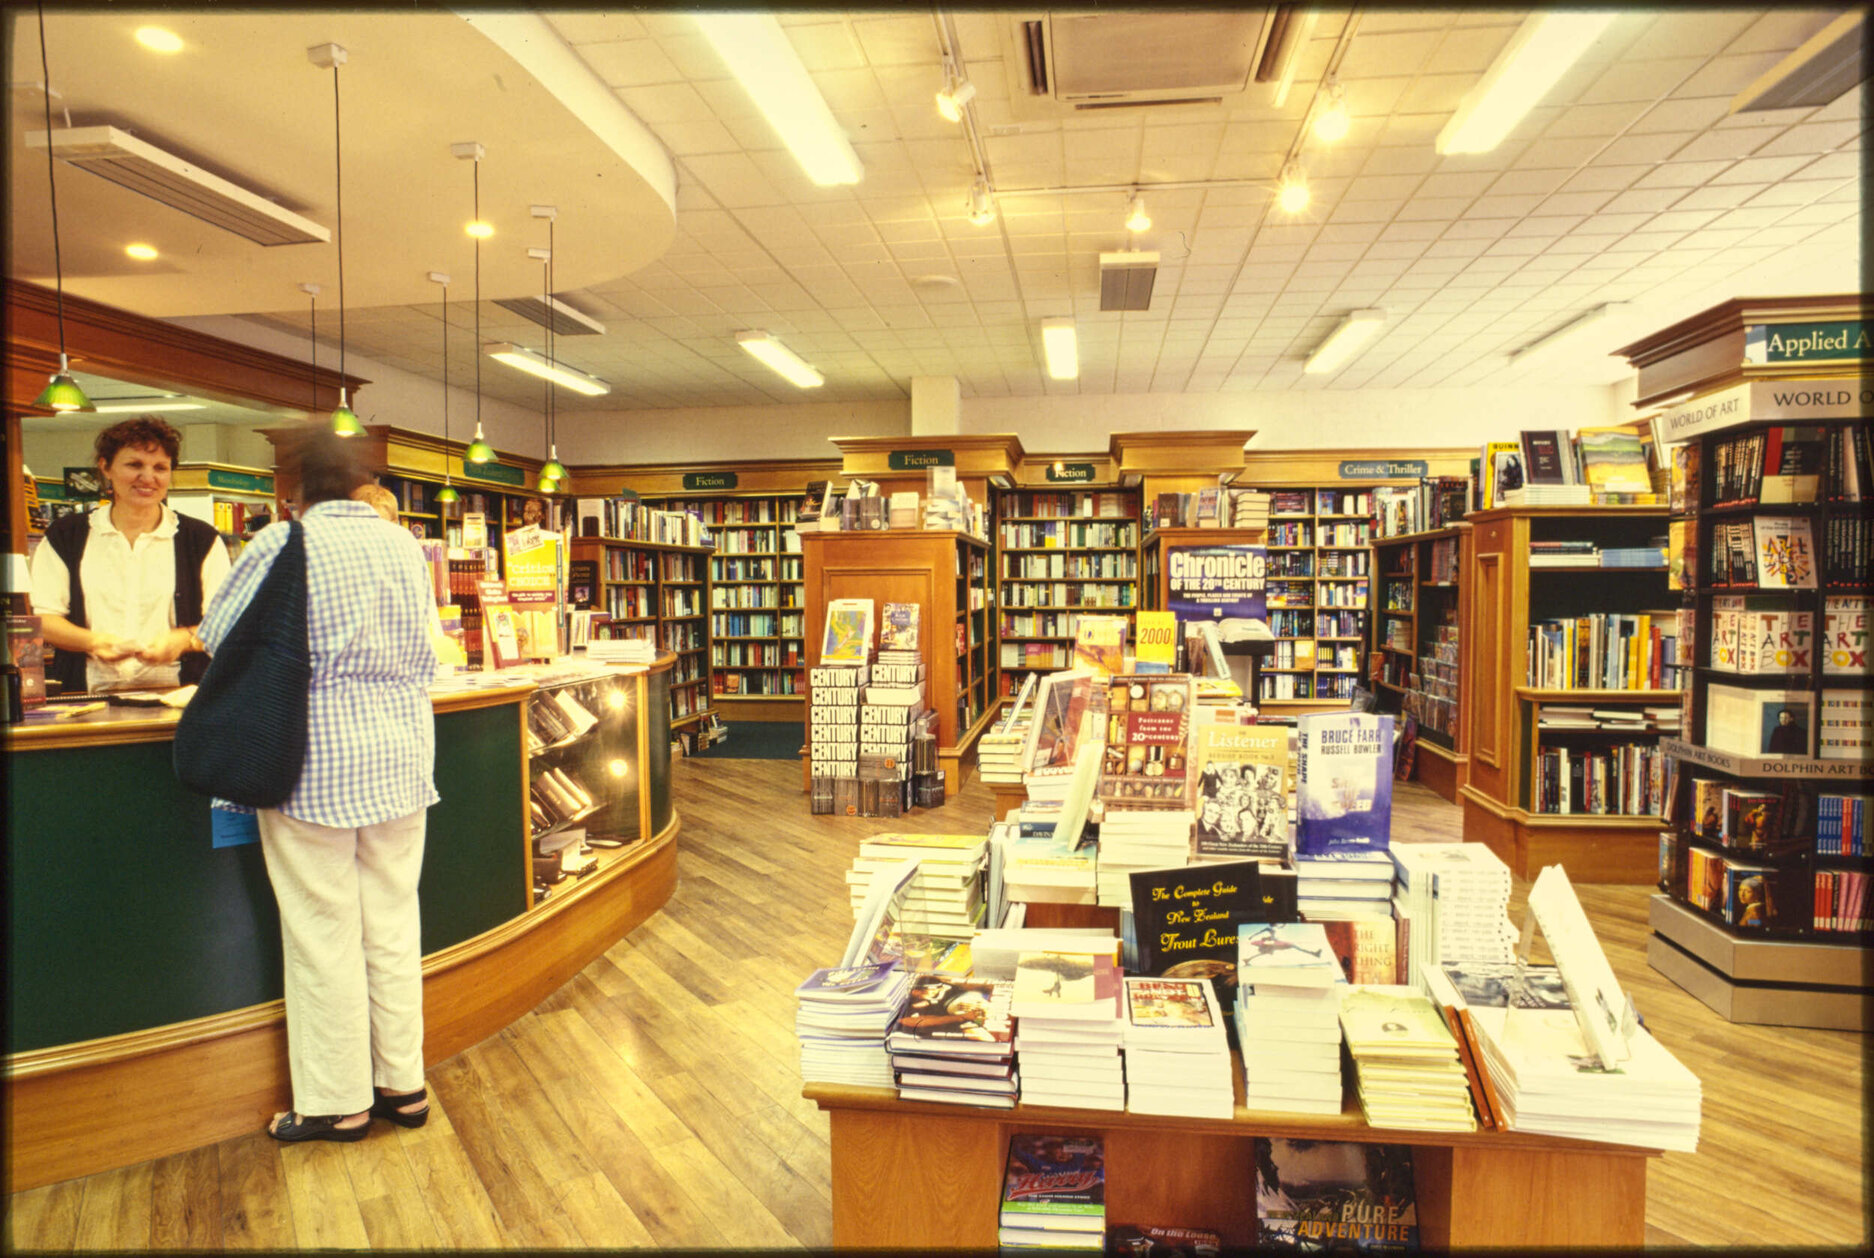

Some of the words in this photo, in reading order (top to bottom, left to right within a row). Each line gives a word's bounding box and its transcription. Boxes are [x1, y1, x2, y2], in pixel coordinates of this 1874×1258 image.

[1767, 329, 1848, 357] Applied
[1773, 390, 1851, 407] WORLD
[1670, 409, 1703, 430] WORLD
[1705, 405, 1717, 420] OF
[1720, 398, 1739, 414] ART
[904, 455, 938, 465] Fiction
[1344, 464, 1374, 475] Crime
[1376, 464, 1385, 474] &
[1387, 463, 1422, 474] Thriller
[695, 476, 725, 487] Fiction
[1170, 552, 1266, 578] Chronicle
[1170, 578, 1183, 591] OF
[1183, 578, 1201, 590] THE
[1223, 578, 1265, 590] CENTURY
[1761, 614, 1809, 631] THE
[1824, 614, 1868, 631] THE
[1140, 628, 1171, 645] 2000
[1761, 631, 1811, 650] ART
[1823, 631, 1869, 650] ART
[1761, 650, 1809, 668] BOX
[1823, 650, 1867, 668] BOX
[811, 668, 857, 687] CENTURY
[872, 664, 917, 682] CENTURY
[812, 687, 859, 705] CENTURY
[811, 706, 859, 724] CENTURY
[861, 705, 910, 724] CENTURY
[811, 724, 858, 742] CENTURY
[861, 724, 909, 743] CENTURY
[1208, 731, 1279, 748] Listener
[1321, 730, 1353, 743] BRUCE
[1357, 730, 1382, 743] FARR
[811, 743, 859, 761] CENTURY
[1321, 745, 1350, 755] RUSSELL
[1353, 744, 1381, 754] BOWLER
[1666, 742, 1693, 759] DOLPHIN
[1693, 749, 1705, 761] ART
[1707, 754, 1731, 769] BOOKS
[811, 761, 857, 778] CENTURY
[1762, 763, 1824, 774] DOLPHIN
[1828, 764, 1856, 775] ART
[1152, 887, 1170, 901] The
[1174, 885, 1211, 900] Complete
[1212, 881, 1238, 896] Guide
[1166, 910, 1191, 925] New
[1193, 908, 1229, 923] Zealand
[1160, 932, 1197, 952] Trout
[1341, 1202, 1399, 1224] PURE
[1151, 1228, 1165, 1236] On
[1166, 1229, 1184, 1237] the
[1297, 1220, 1409, 1242] ADVENTURE
